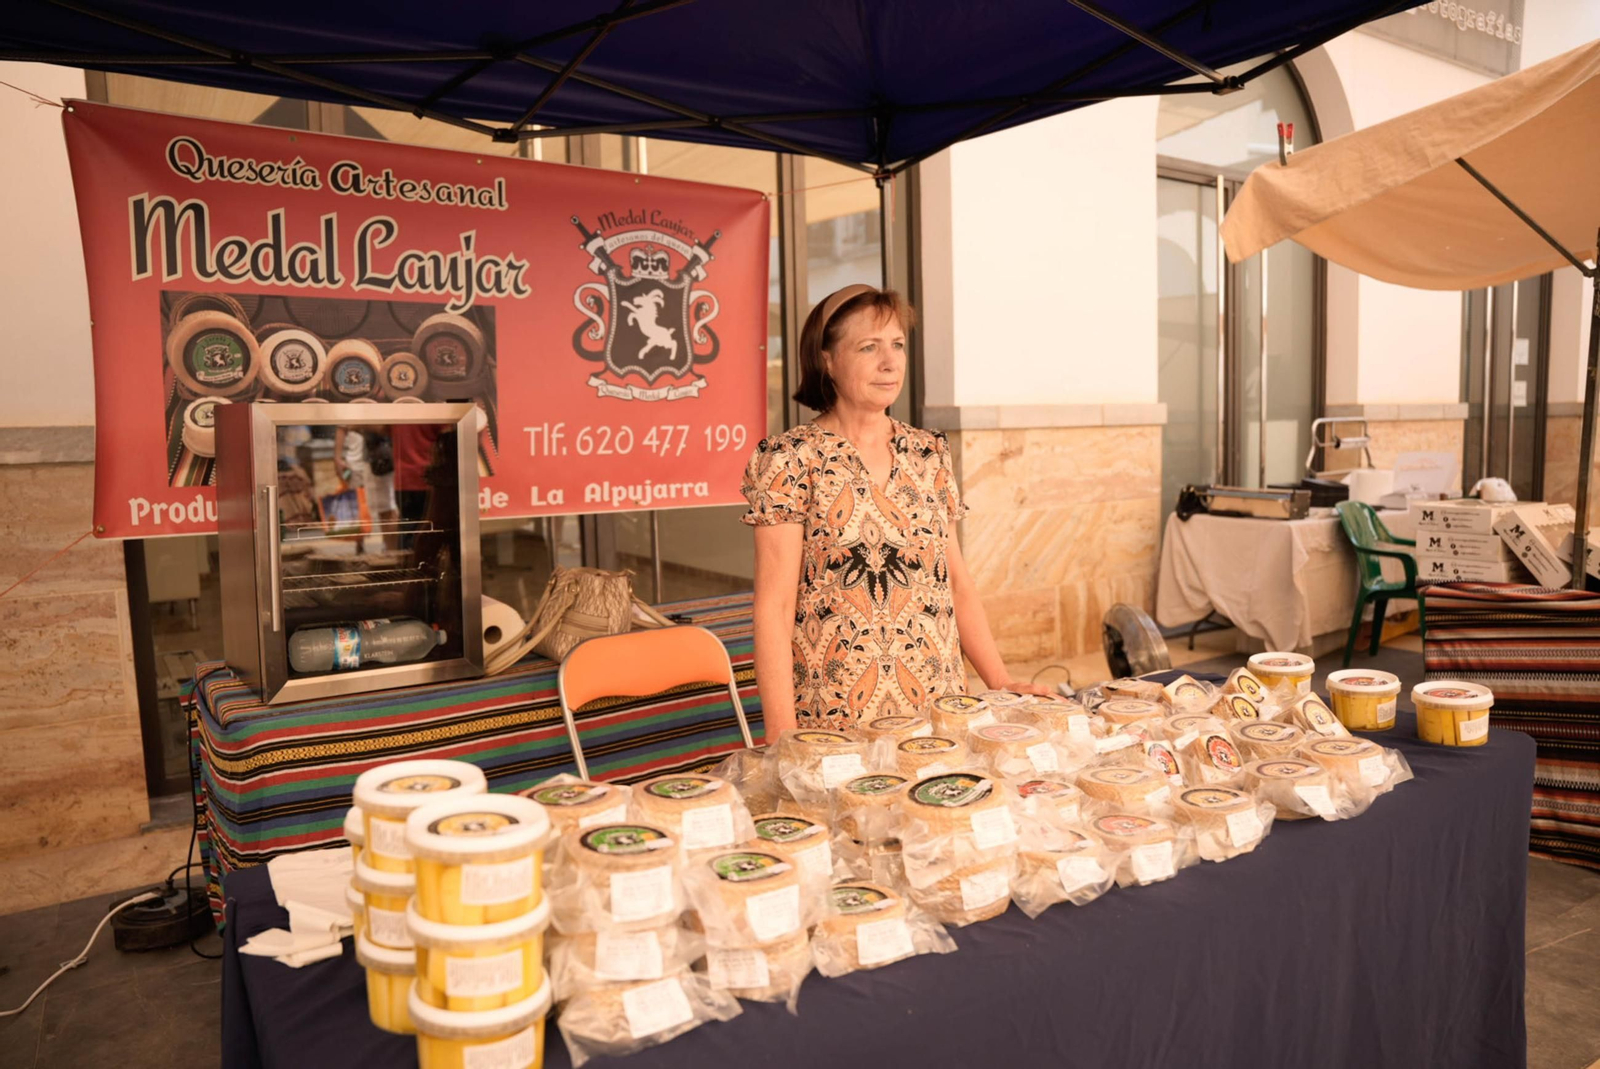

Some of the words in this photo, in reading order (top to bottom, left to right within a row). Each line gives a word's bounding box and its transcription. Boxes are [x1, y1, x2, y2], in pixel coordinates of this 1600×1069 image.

[1419, 0, 1521, 44] otografías
[165, 135, 321, 191] Quesería
[597, 208, 647, 232] Medal
[650, 209, 696, 240] Laujar
[128, 192, 344, 286] Medal
[350, 215, 532, 314] Laujar
[523, 422, 568, 456] Tlf.
[576, 425, 634, 456] 620
[642, 424, 690, 457] 477
[704, 423, 747, 452] 199
[478, 487, 509, 509] de
[531, 486, 564, 507] La
[584, 479, 709, 507] Alpujarra
[1422, 510, 1434, 521] M
[1429, 537, 1441, 548] M
[1432, 562, 1444, 573] M
